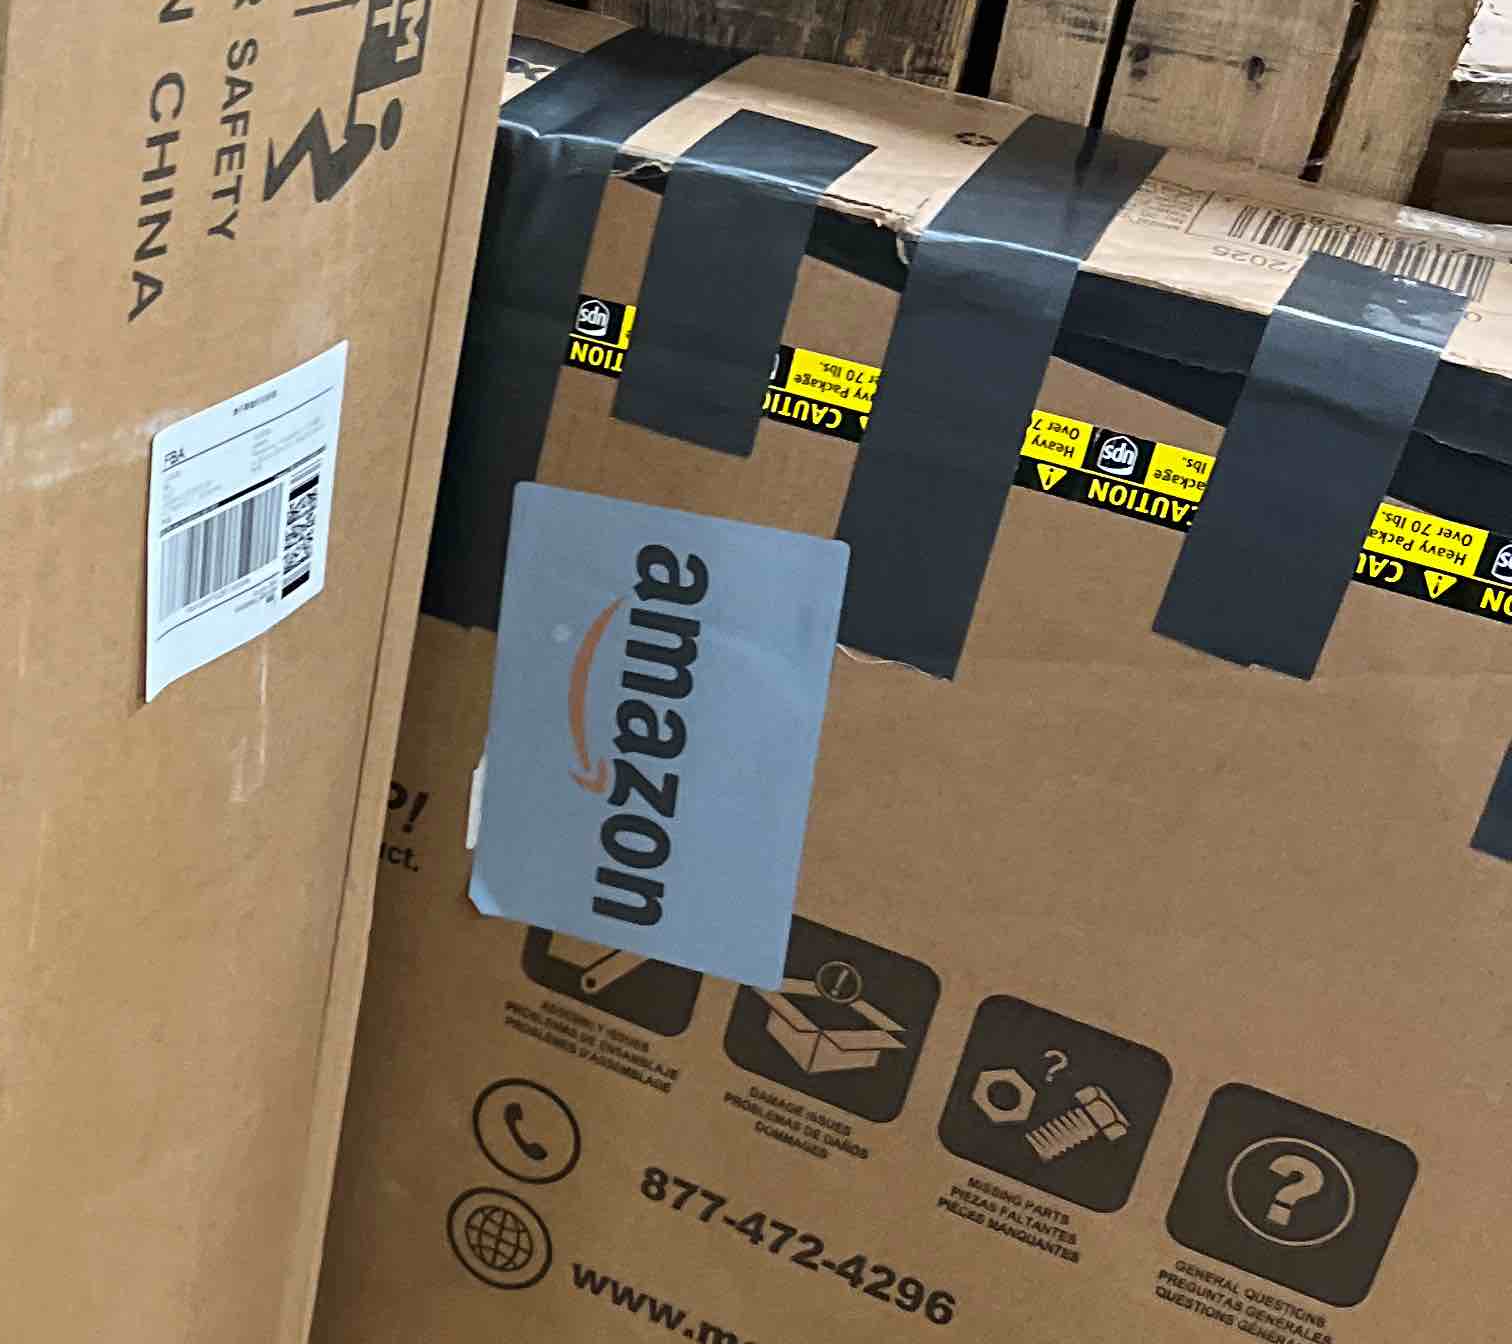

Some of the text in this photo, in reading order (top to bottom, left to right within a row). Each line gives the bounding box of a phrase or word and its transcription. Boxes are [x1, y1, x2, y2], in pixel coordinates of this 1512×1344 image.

[206, 37, 259, 241] SAFETY
[127, 71, 185, 322] CHINA
[793, 372, 848, 400] Package
[761, 391, 842, 430] CAUTI
[1046, 421, 1081, 441] Over
[1031, 433, 1076, 460] Heavy
[1381, 510, 1473, 547] Over 70 lbs.
[1418, 541, 1468, 566] Heavy
[591, 542, 709, 927] amazon
[951, 1184, 1078, 1245] PIEZAS FALTANTES
[1025, 1199, 1071, 1225] PARTS
[640, 1166, 958, 1327] 877-472-4296
[987, 1217, 1080, 1264] MANQUANTES
[1155, 1285, 1234, 1326] QUESTIONS
[1158, 1269, 1243, 1311] PREGUNTAS
[1175, 1259, 1326, 1329] GENERAL QUESTIONS
